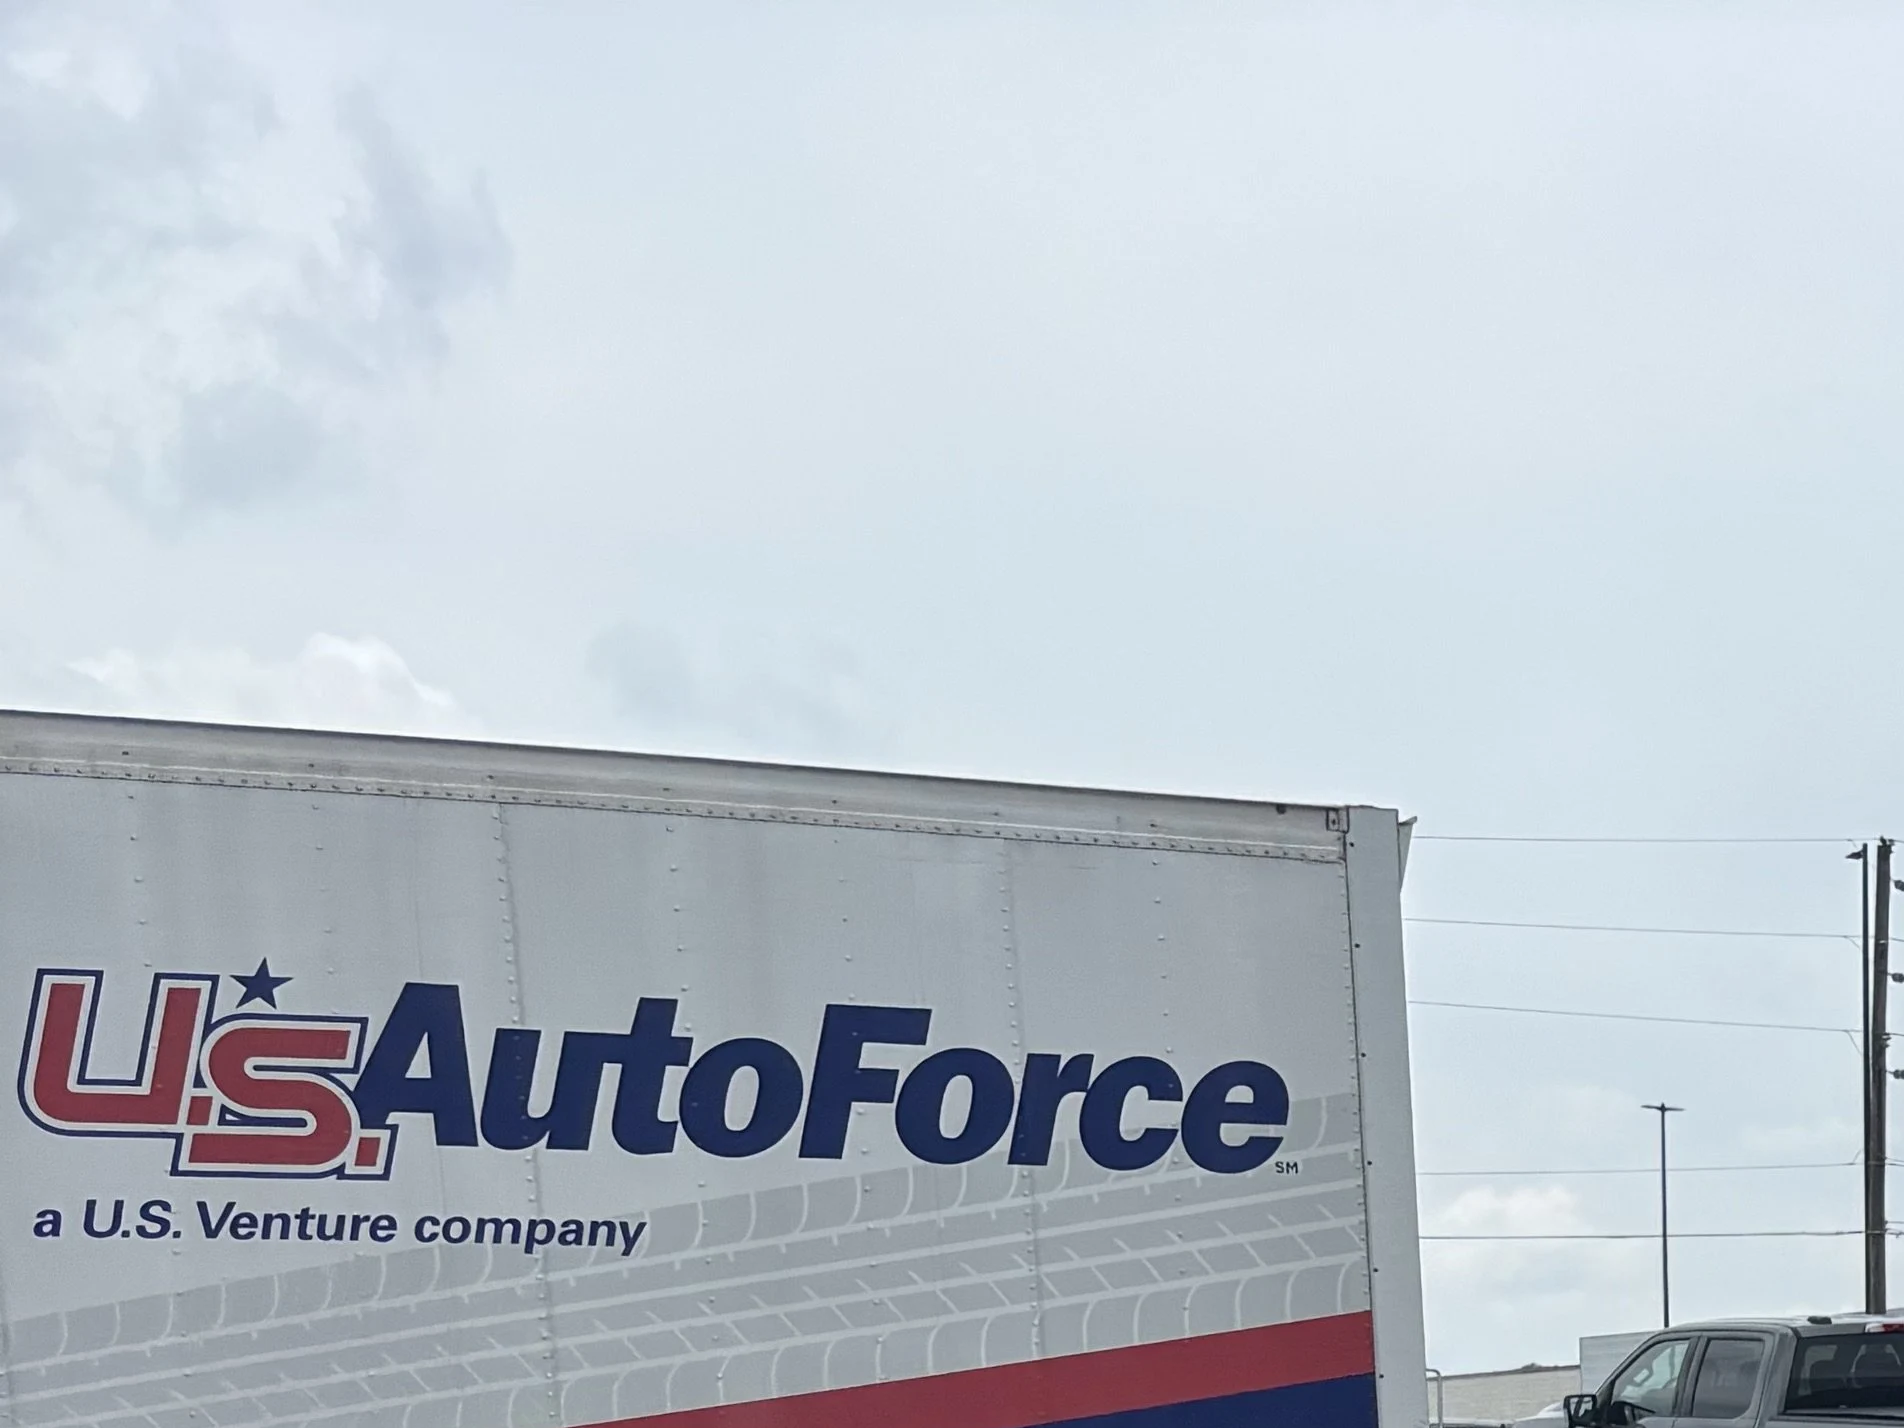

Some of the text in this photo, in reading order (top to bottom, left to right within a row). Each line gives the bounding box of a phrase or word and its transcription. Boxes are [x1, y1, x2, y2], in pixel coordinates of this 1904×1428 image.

[355, 981, 1290, 1175] AutoForce
[33, 1199, 648, 1257] a U.S. Venture company
